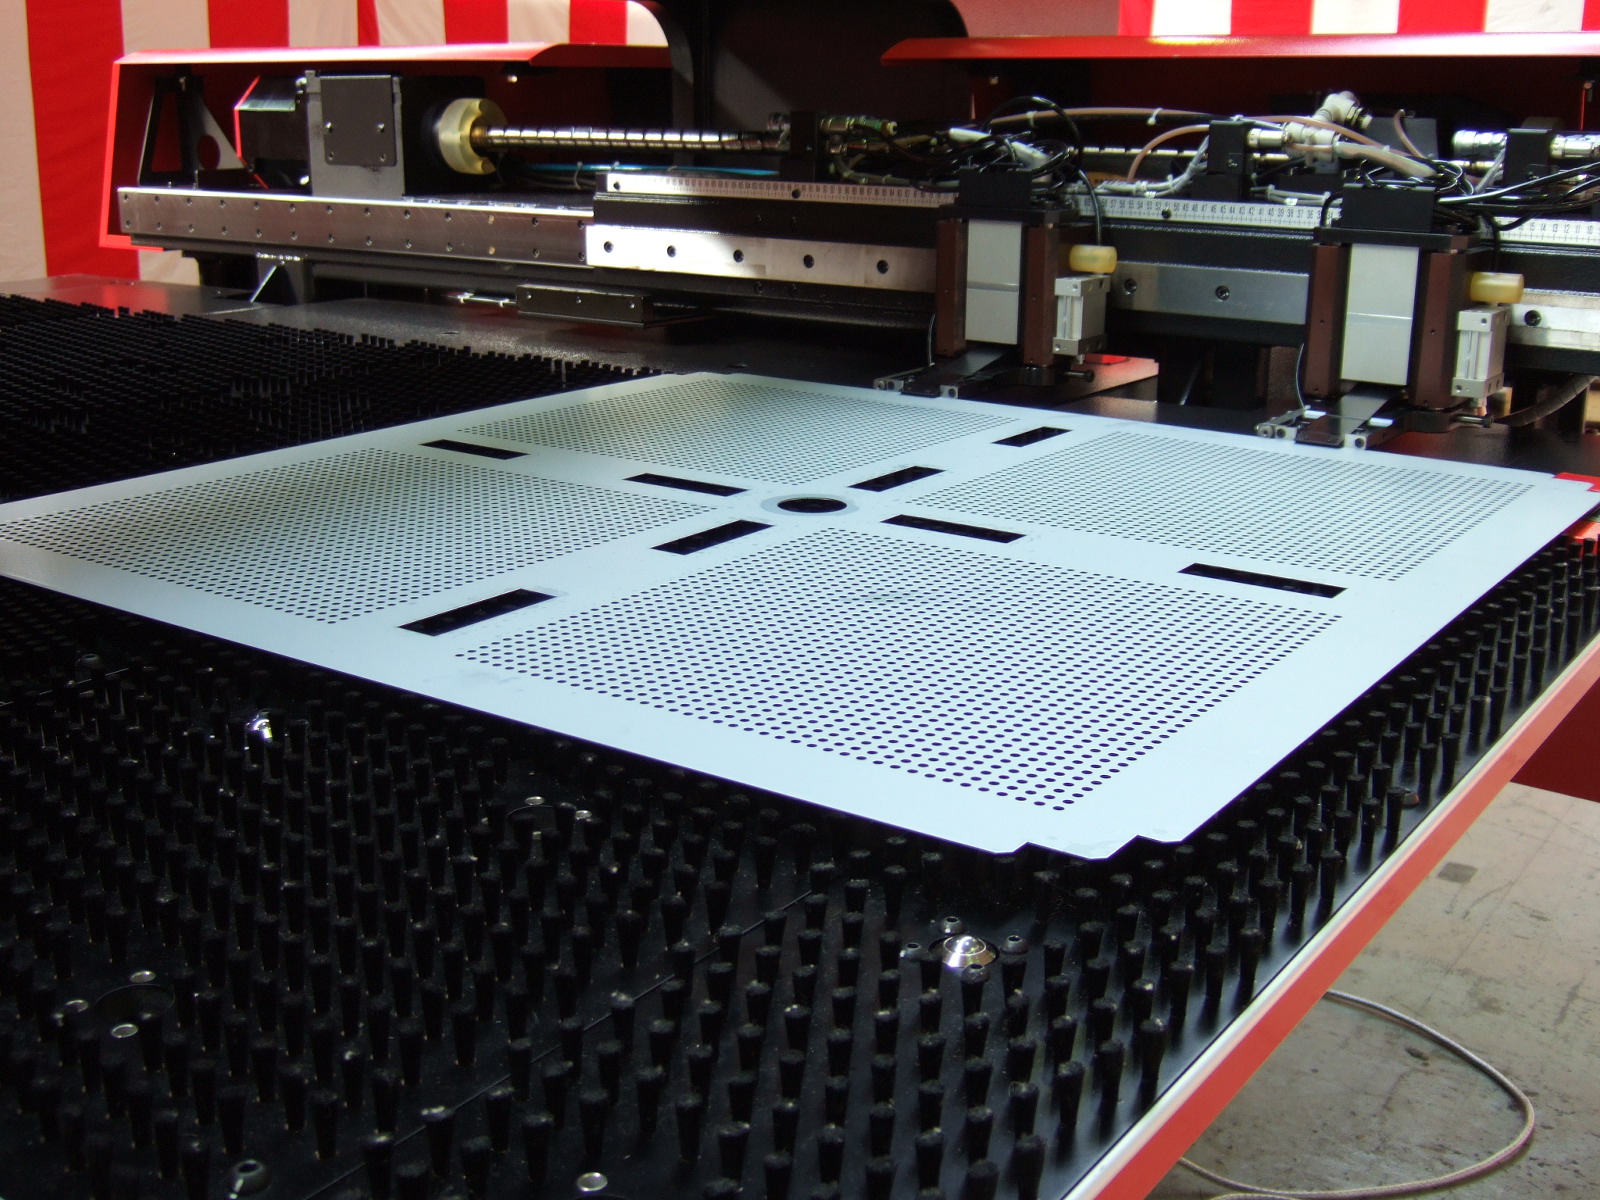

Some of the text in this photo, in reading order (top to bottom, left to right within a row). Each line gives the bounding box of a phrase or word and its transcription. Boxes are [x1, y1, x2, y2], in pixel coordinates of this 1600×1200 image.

[1174, 202, 1180, 211] 50
[1183, 203, 1189, 212] 49
[1192, 203, 1198, 212] 48
[1201, 204, 1208, 213] 47
[1220, 205, 1226, 213] 45
[1229, 205, 1236, 214] 44
[1239, 206, 1245, 215] 43
[1249, 206, 1255, 215] 42
[1259, 207, 1264, 215] 41
[1278, 208, 1284, 217] 39
[1287, 208, 1293, 217] 38
[1297, 209, 1304, 218] 37
[1541, 222, 1547, 232] 14
[1553, 223, 1558, 233] 13
[1564, 223, 1570, 233] 12
[1576, 224, 1580, 234] 11
[1587, 225, 1593, 234] 10
